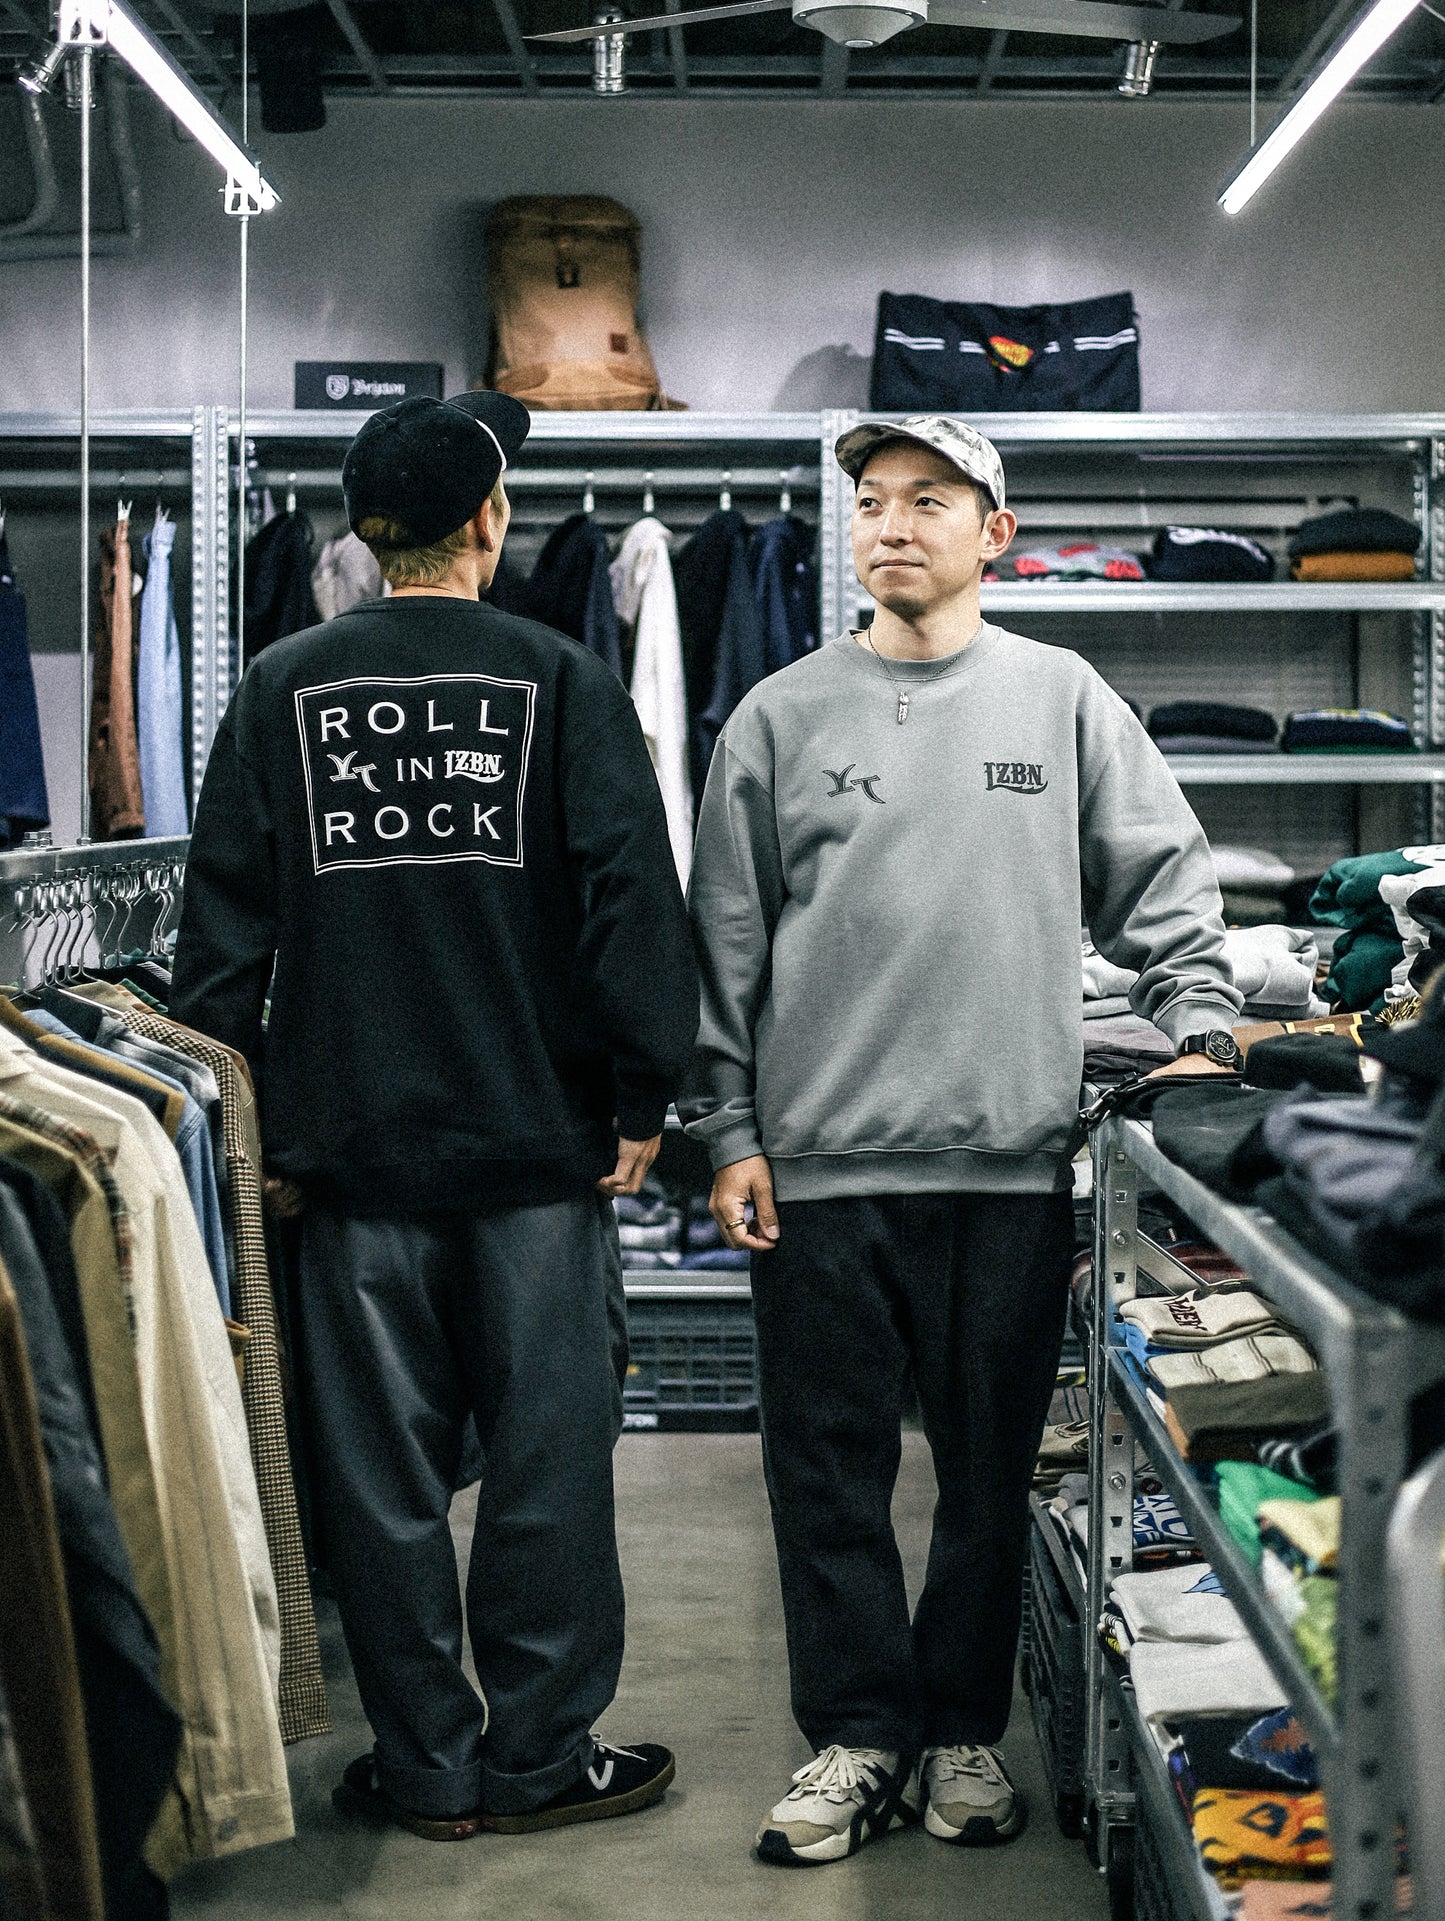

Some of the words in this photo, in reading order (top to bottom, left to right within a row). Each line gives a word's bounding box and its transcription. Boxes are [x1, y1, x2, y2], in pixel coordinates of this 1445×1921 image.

[319, 699, 509, 743] ROLL
[396, 756, 434, 782] IN
[323, 802, 502, 846] ROCK
